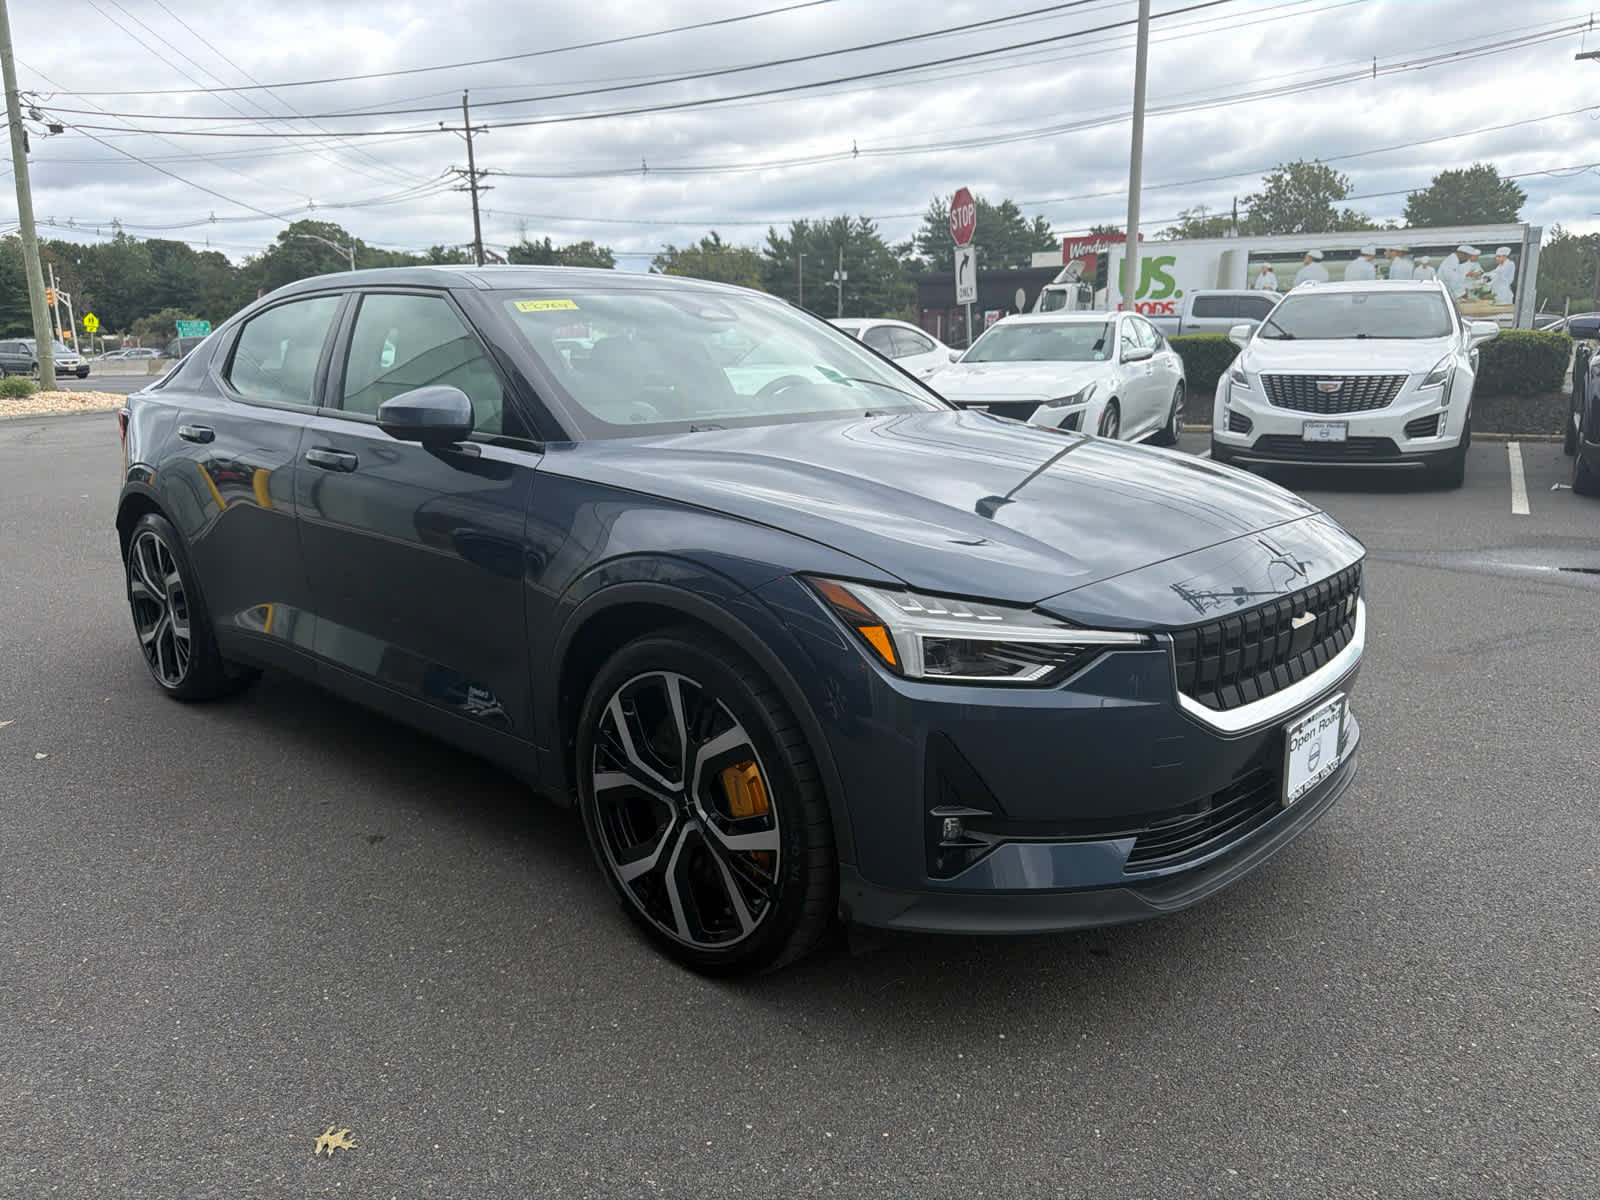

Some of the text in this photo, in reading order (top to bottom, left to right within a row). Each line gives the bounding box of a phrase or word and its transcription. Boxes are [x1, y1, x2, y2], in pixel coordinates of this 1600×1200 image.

[951, 203, 974, 231] STOP
[1069, 239, 1109, 259] Wendy
[959, 287, 974, 299] ONLY
[1290, 709, 1340, 752] Open Road
